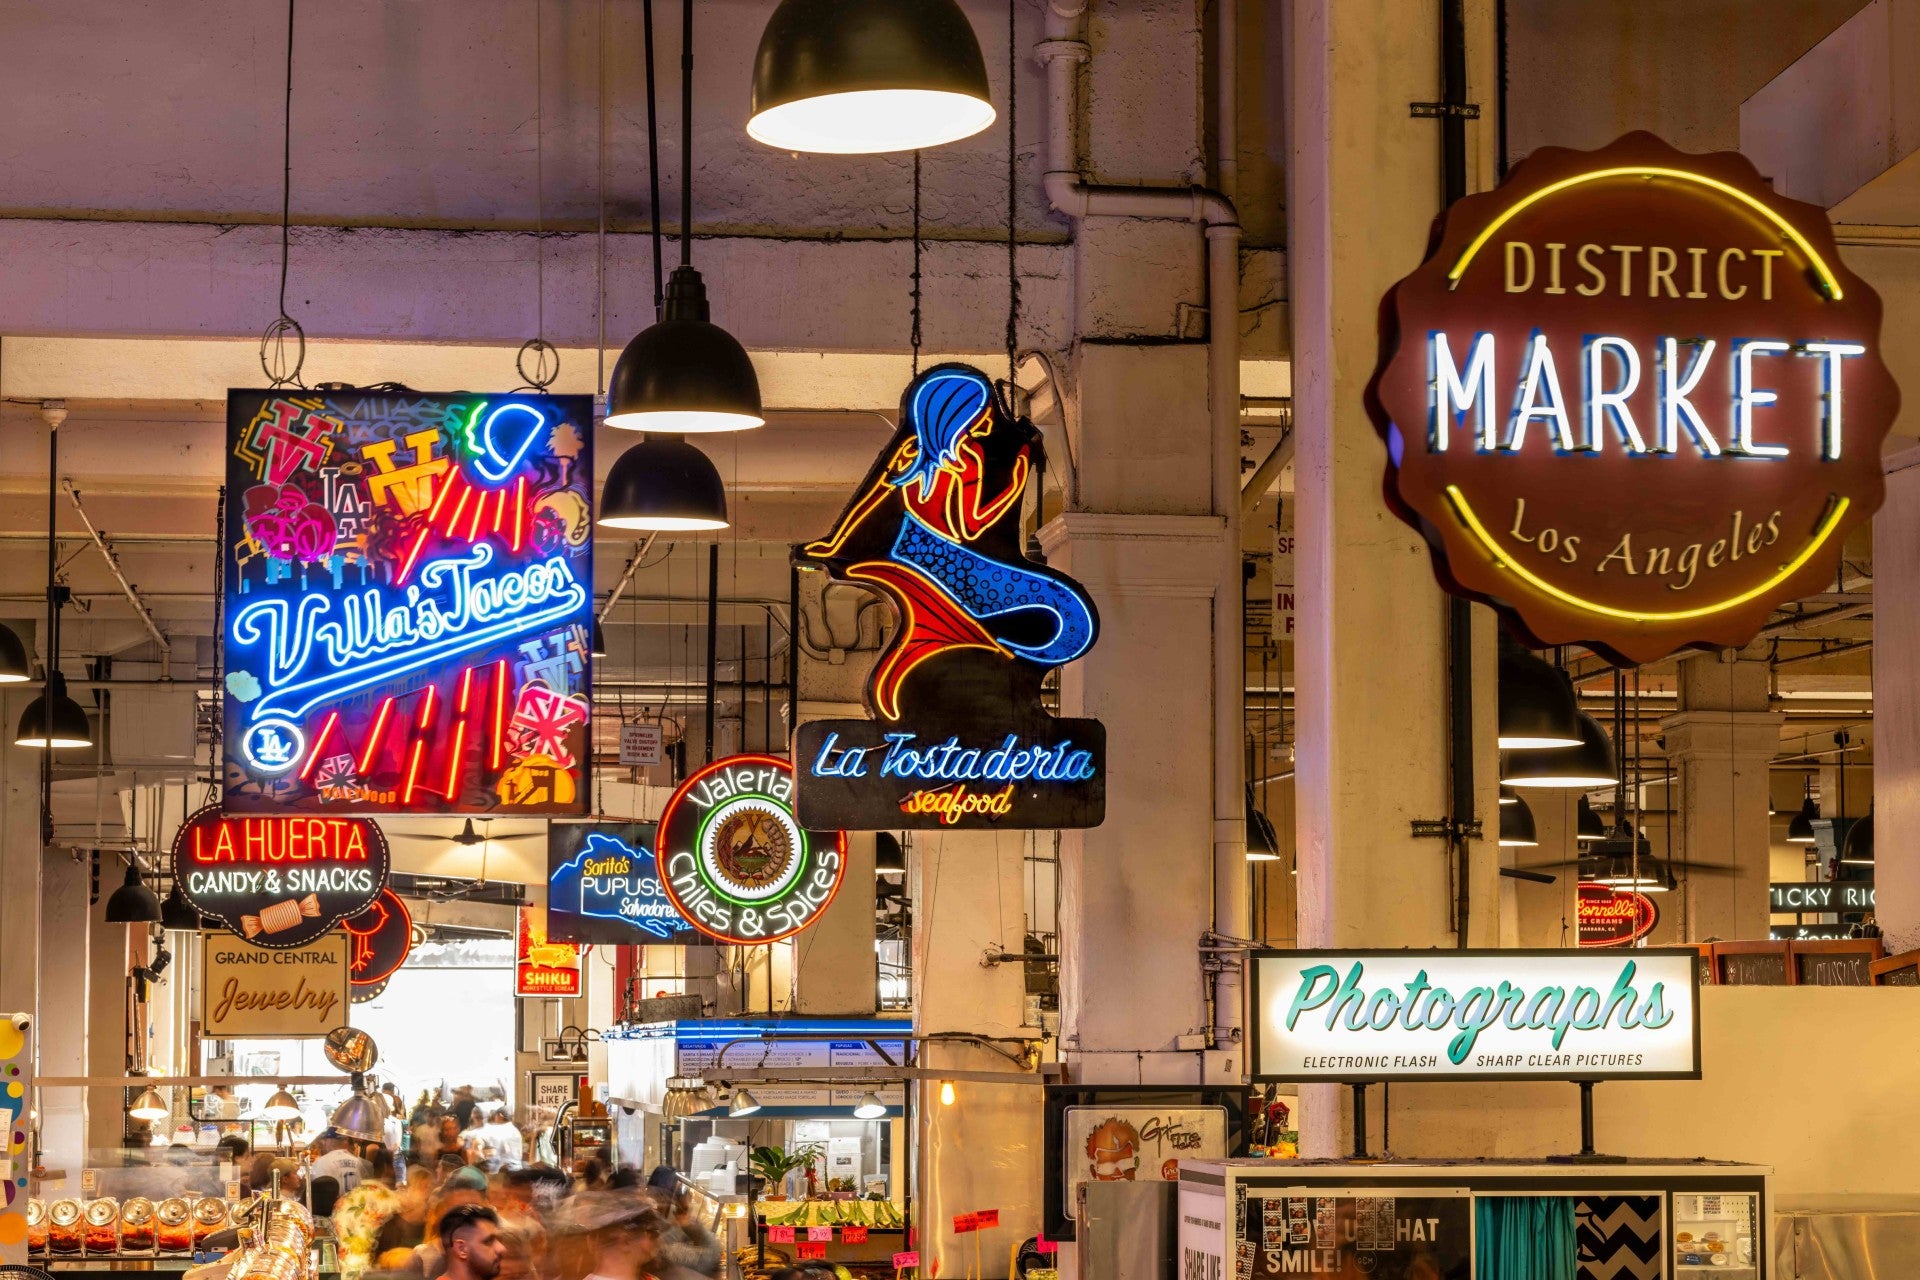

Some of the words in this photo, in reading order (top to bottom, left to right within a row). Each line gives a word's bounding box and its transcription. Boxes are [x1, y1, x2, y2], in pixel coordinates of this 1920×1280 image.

[1505, 241, 1784, 300] DISTRICT
[1429, 330, 1865, 461] MARKET
[1509, 498, 1580, 563] Los
[1597, 510, 1782, 590] Angeles
[233, 585, 444, 687] Villa's
[421, 543, 574, 633] Tacos
[812, 732, 867, 777] La
[687, 767, 793, 807] Valeria
[902, 784, 1014, 824] seafood
[195, 823, 234, 861] LA
[246, 818, 366, 861] HUERTA
[190, 871, 261, 893] CANDY
[264, 868, 281, 893] &
[287, 867, 372, 893] SNACKS
[669, 852, 731, 930] Chiles
[739, 908, 766, 936] &
[766, 851, 839, 935] Spices
[215, 952, 269, 965] GRAND
[273, 951, 338, 964] CENTRAL
[525, 972, 571, 985] SHIKU
[212, 976, 339, 1023] Jewelry
[1285, 959, 1675, 1065] Photographs
[1303, 1056, 1389, 1068] ELECTRONIC
[1394, 1055, 1437, 1067] FLASH
[1476, 1055, 1523, 1067] SHARP
[1527, 1054, 1571, 1066] CLEAR
[1576, 1054, 1643, 1066] PICTURES
[1397, 1219, 1440, 1241] HAT
[1266, 1251, 1342, 1273] SMILE!
